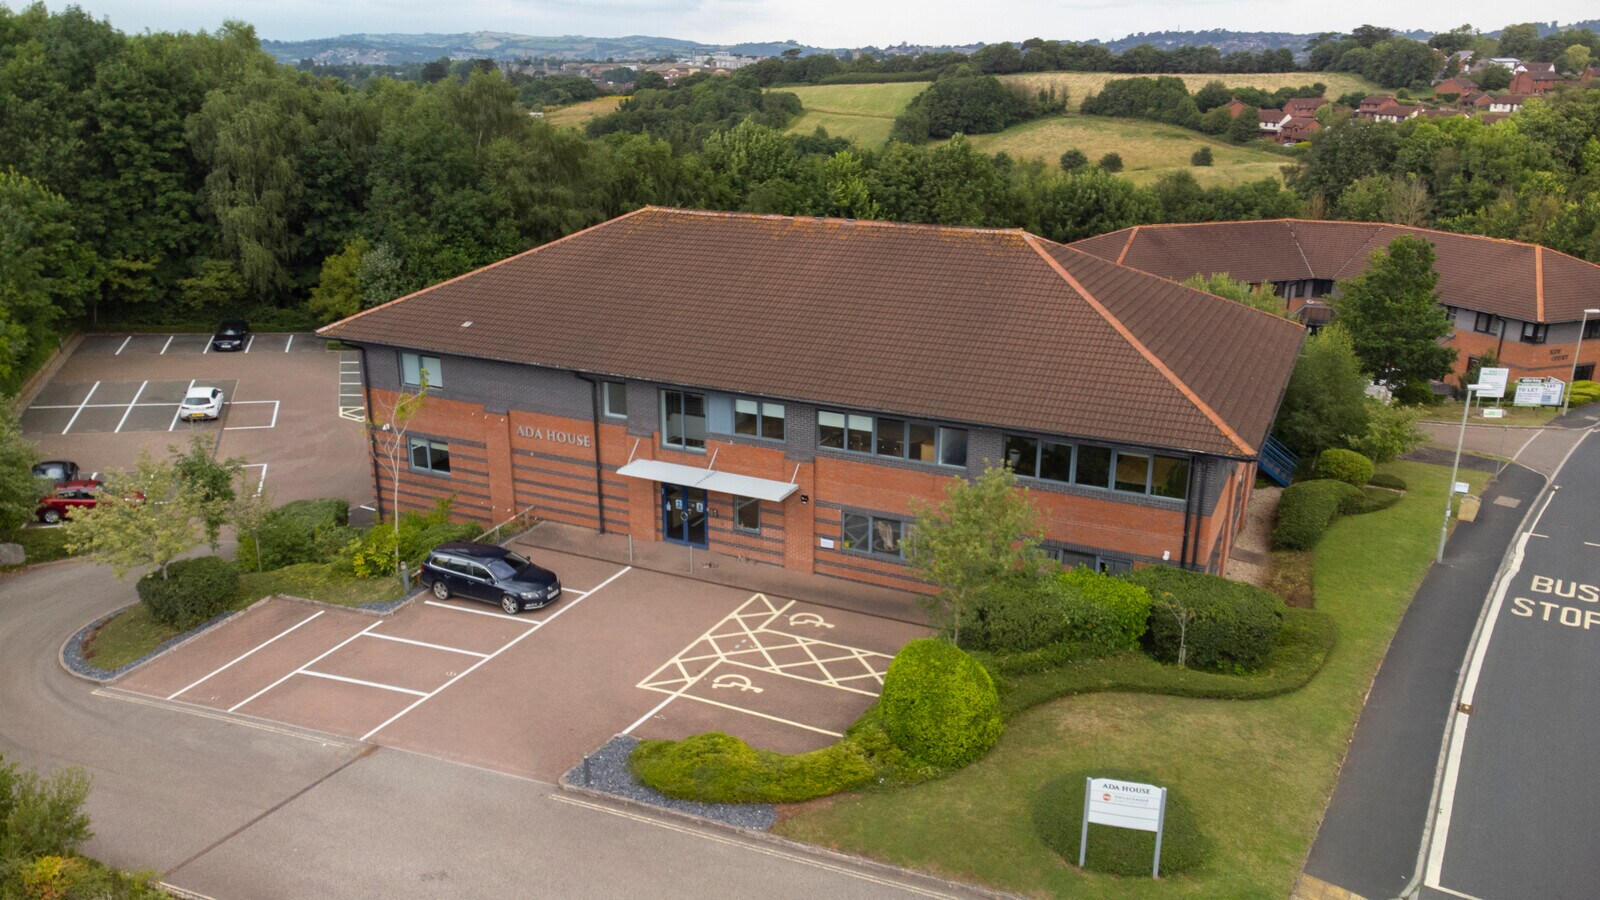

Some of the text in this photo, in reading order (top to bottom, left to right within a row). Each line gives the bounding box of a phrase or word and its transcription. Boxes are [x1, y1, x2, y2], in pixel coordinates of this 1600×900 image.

[516, 424, 591, 448] ADA HOUSE
[1530, 574, 1600, 603] BUS
[1510, 597, 1600, 630] STOP
[1102, 783, 1151, 795] ADA HOUSE
